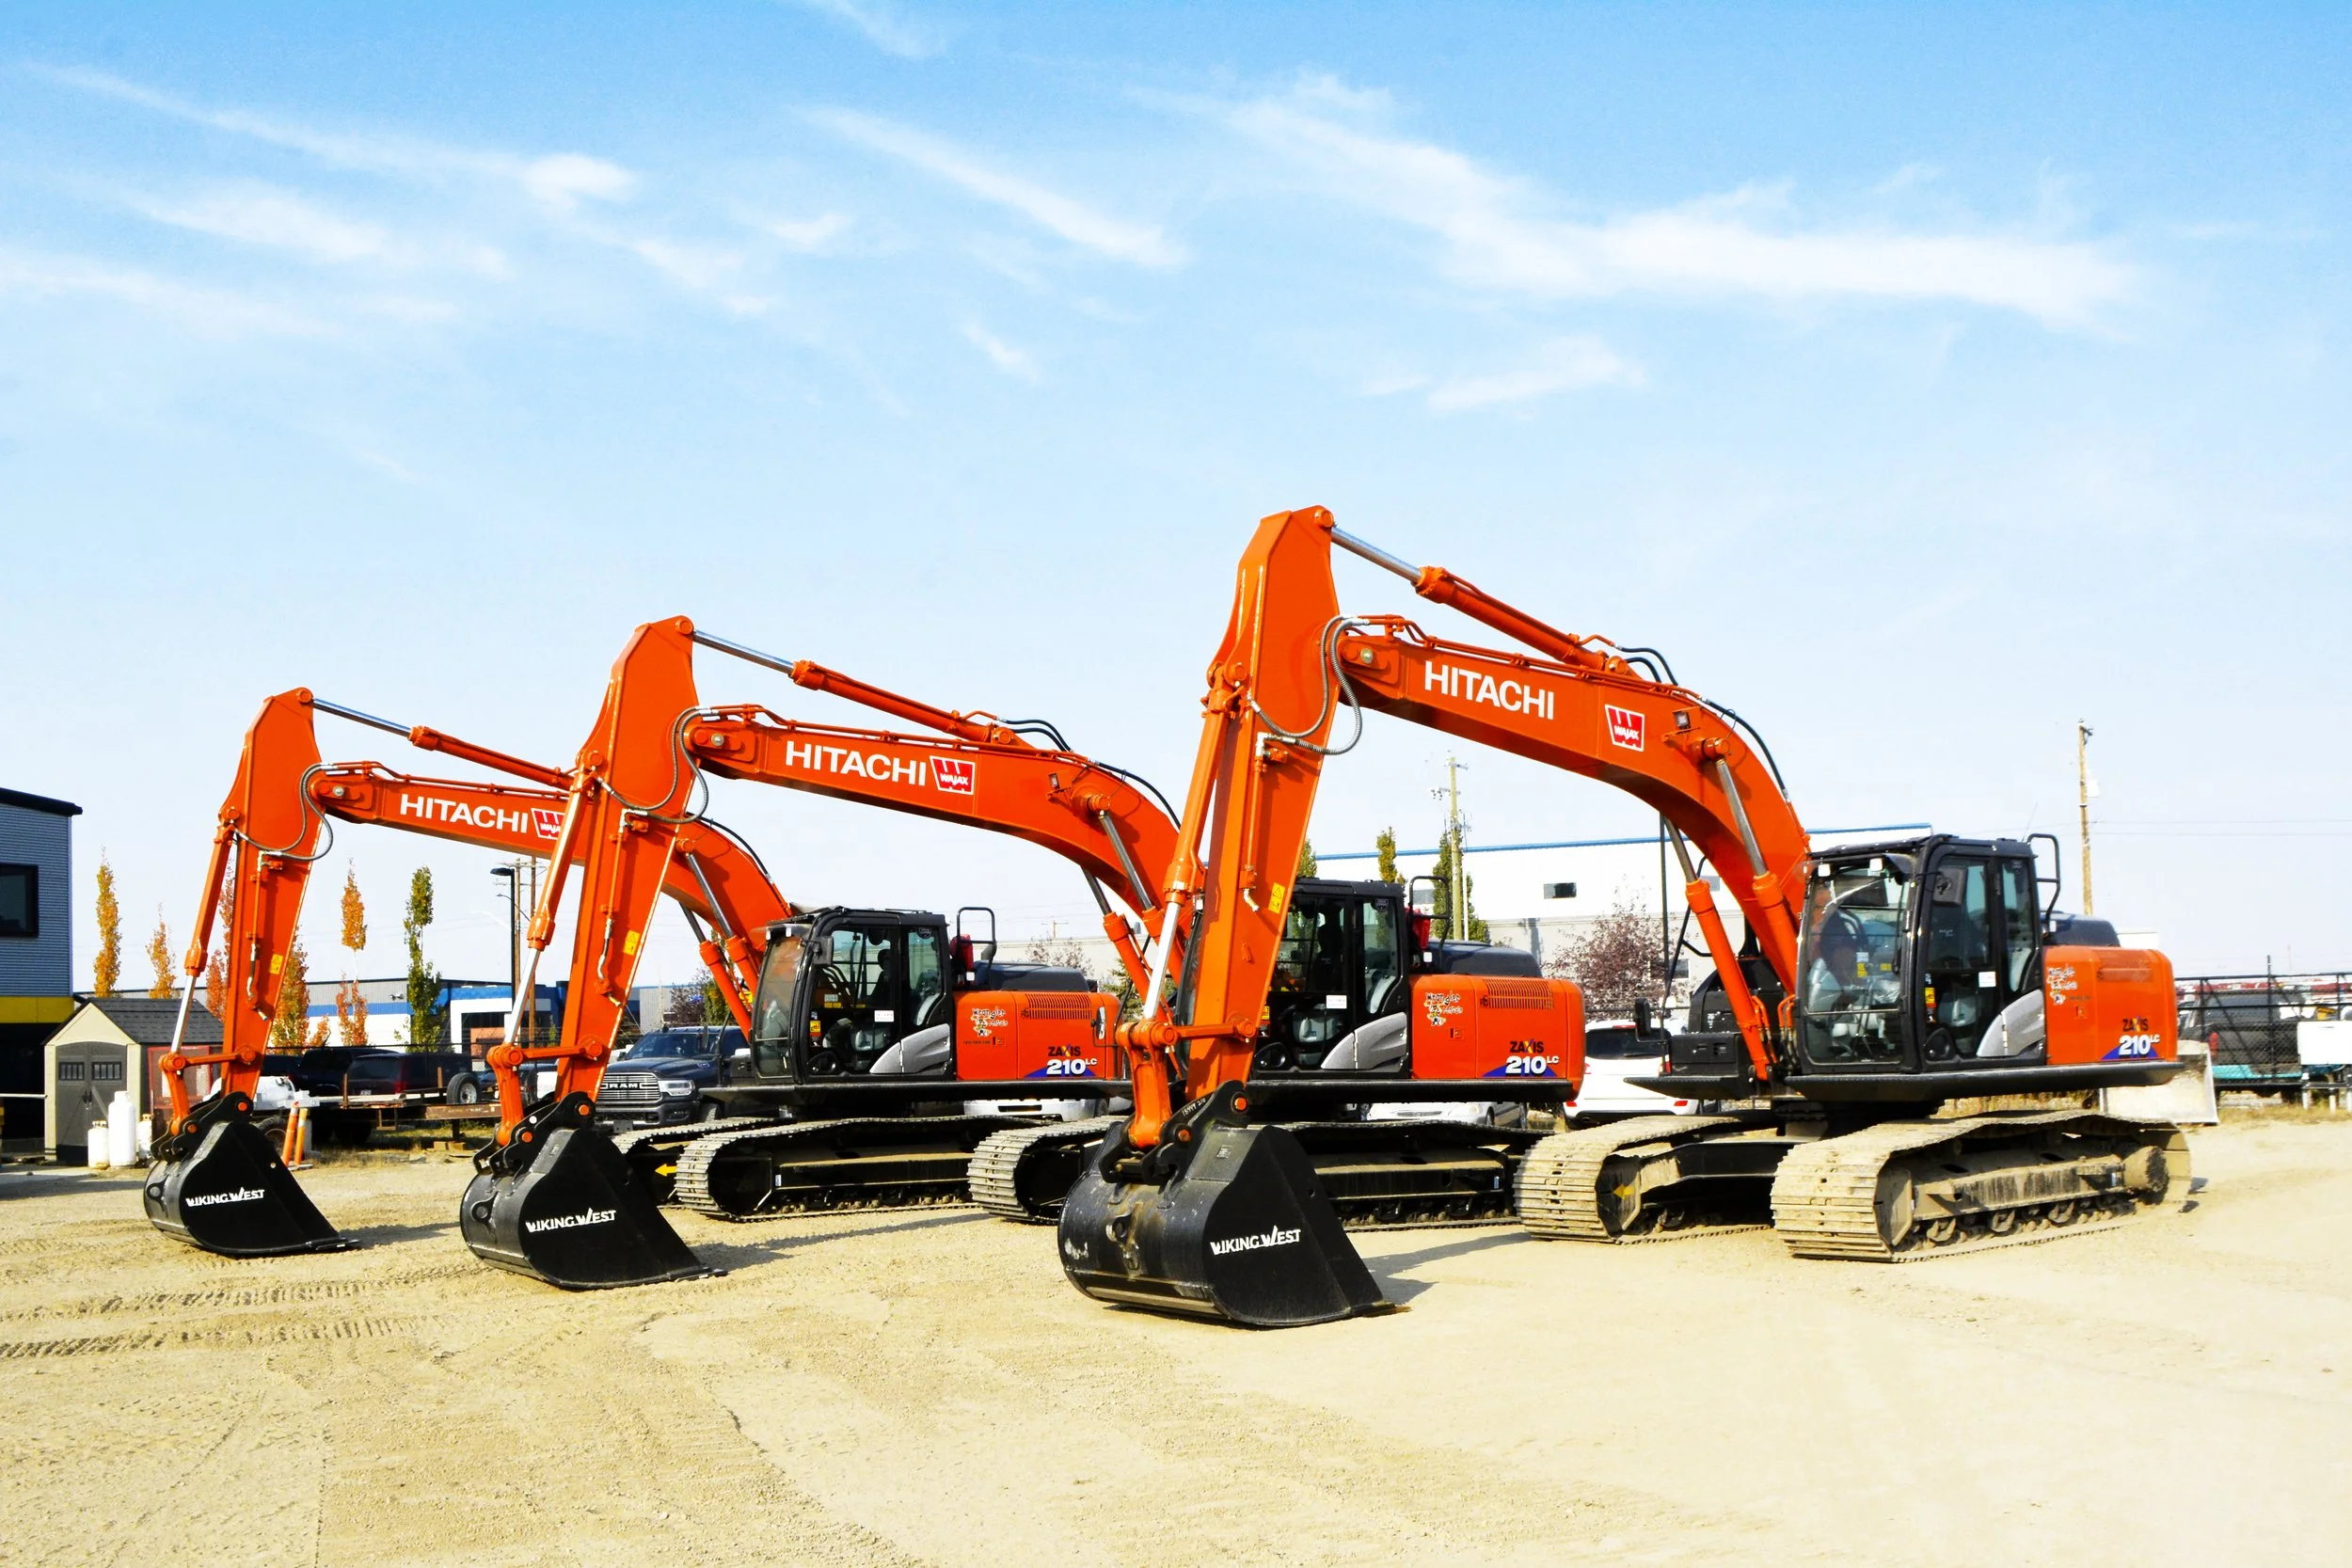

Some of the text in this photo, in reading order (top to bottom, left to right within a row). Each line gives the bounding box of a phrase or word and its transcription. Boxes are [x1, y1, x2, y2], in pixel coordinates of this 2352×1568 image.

[1424, 660, 1554, 721] HITACHI
[1613, 725, 1640, 740] WAJAX
[786, 740, 927, 786] HITACHI
[940, 773, 969, 785] WAJAX
[400, 793, 529, 833] HITACHI
[2122, 1016, 2150, 1032] ZAXIS
[1047, 1044, 1081, 1057] ZAXIS
[1510, 1039, 1544, 1053] ZAXIS
[185, 1186, 265, 1207] VIKING WEST
[525, 1207, 616, 1233] VIKING WEST
[1210, 1225, 1301, 1256] VIKING WEST
